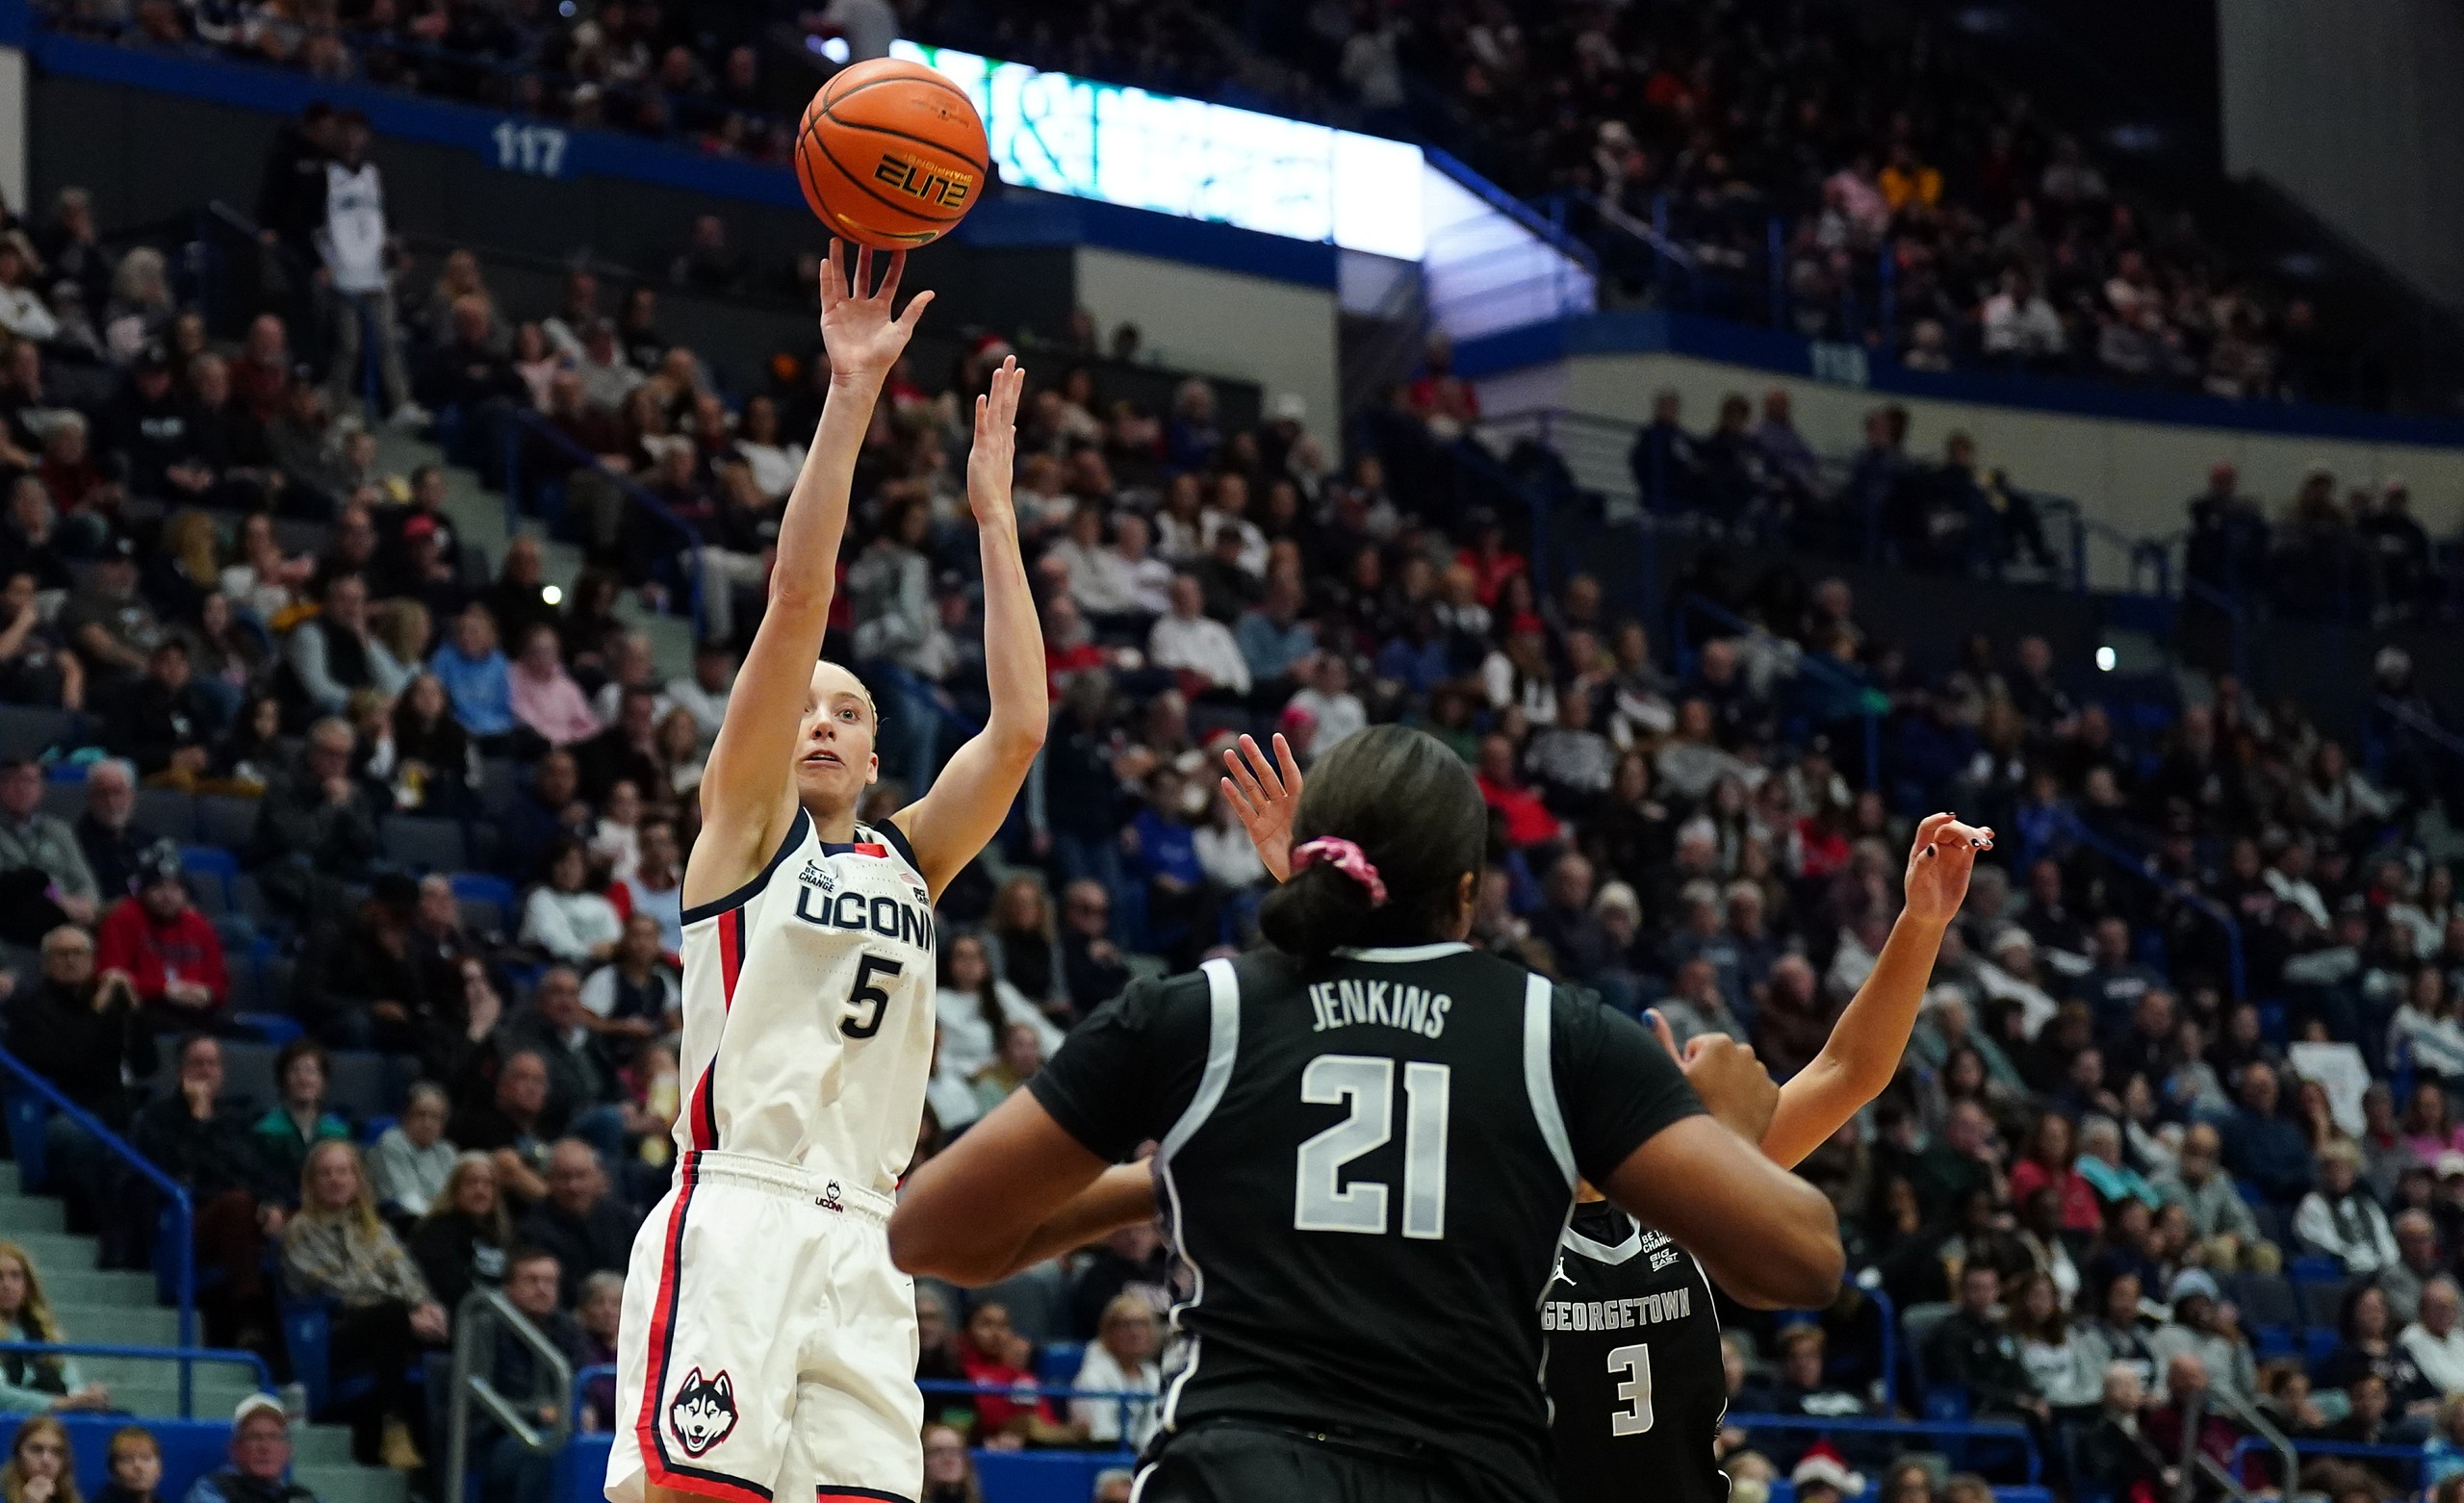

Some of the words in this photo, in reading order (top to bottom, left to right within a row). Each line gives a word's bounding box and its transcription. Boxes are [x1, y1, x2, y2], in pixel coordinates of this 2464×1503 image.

[493, 121, 567, 176] 117
[873, 153, 969, 211] ELITE
[798, 872, 835, 893] CHANGE
[805, 866, 815, 876] BE
[818, 874, 834, 884] THE
[839, 951, 905, 1040] 5
[1308, 979, 1452, 1039] JENKINS
[1294, 1054, 1451, 1240] 21
[814, 1196, 844, 1213] UCONN
[1641, 1232, 1655, 1244] BE
[1642, 1235, 1674, 1254] CHANG
[1649, 1247, 1670, 1262] BIG
[1652, 1252, 1679, 1269] EAST
[1540, 1287, 1691, 1332] GEORGETOWN
[1606, 1343, 1655, 1437] 3
